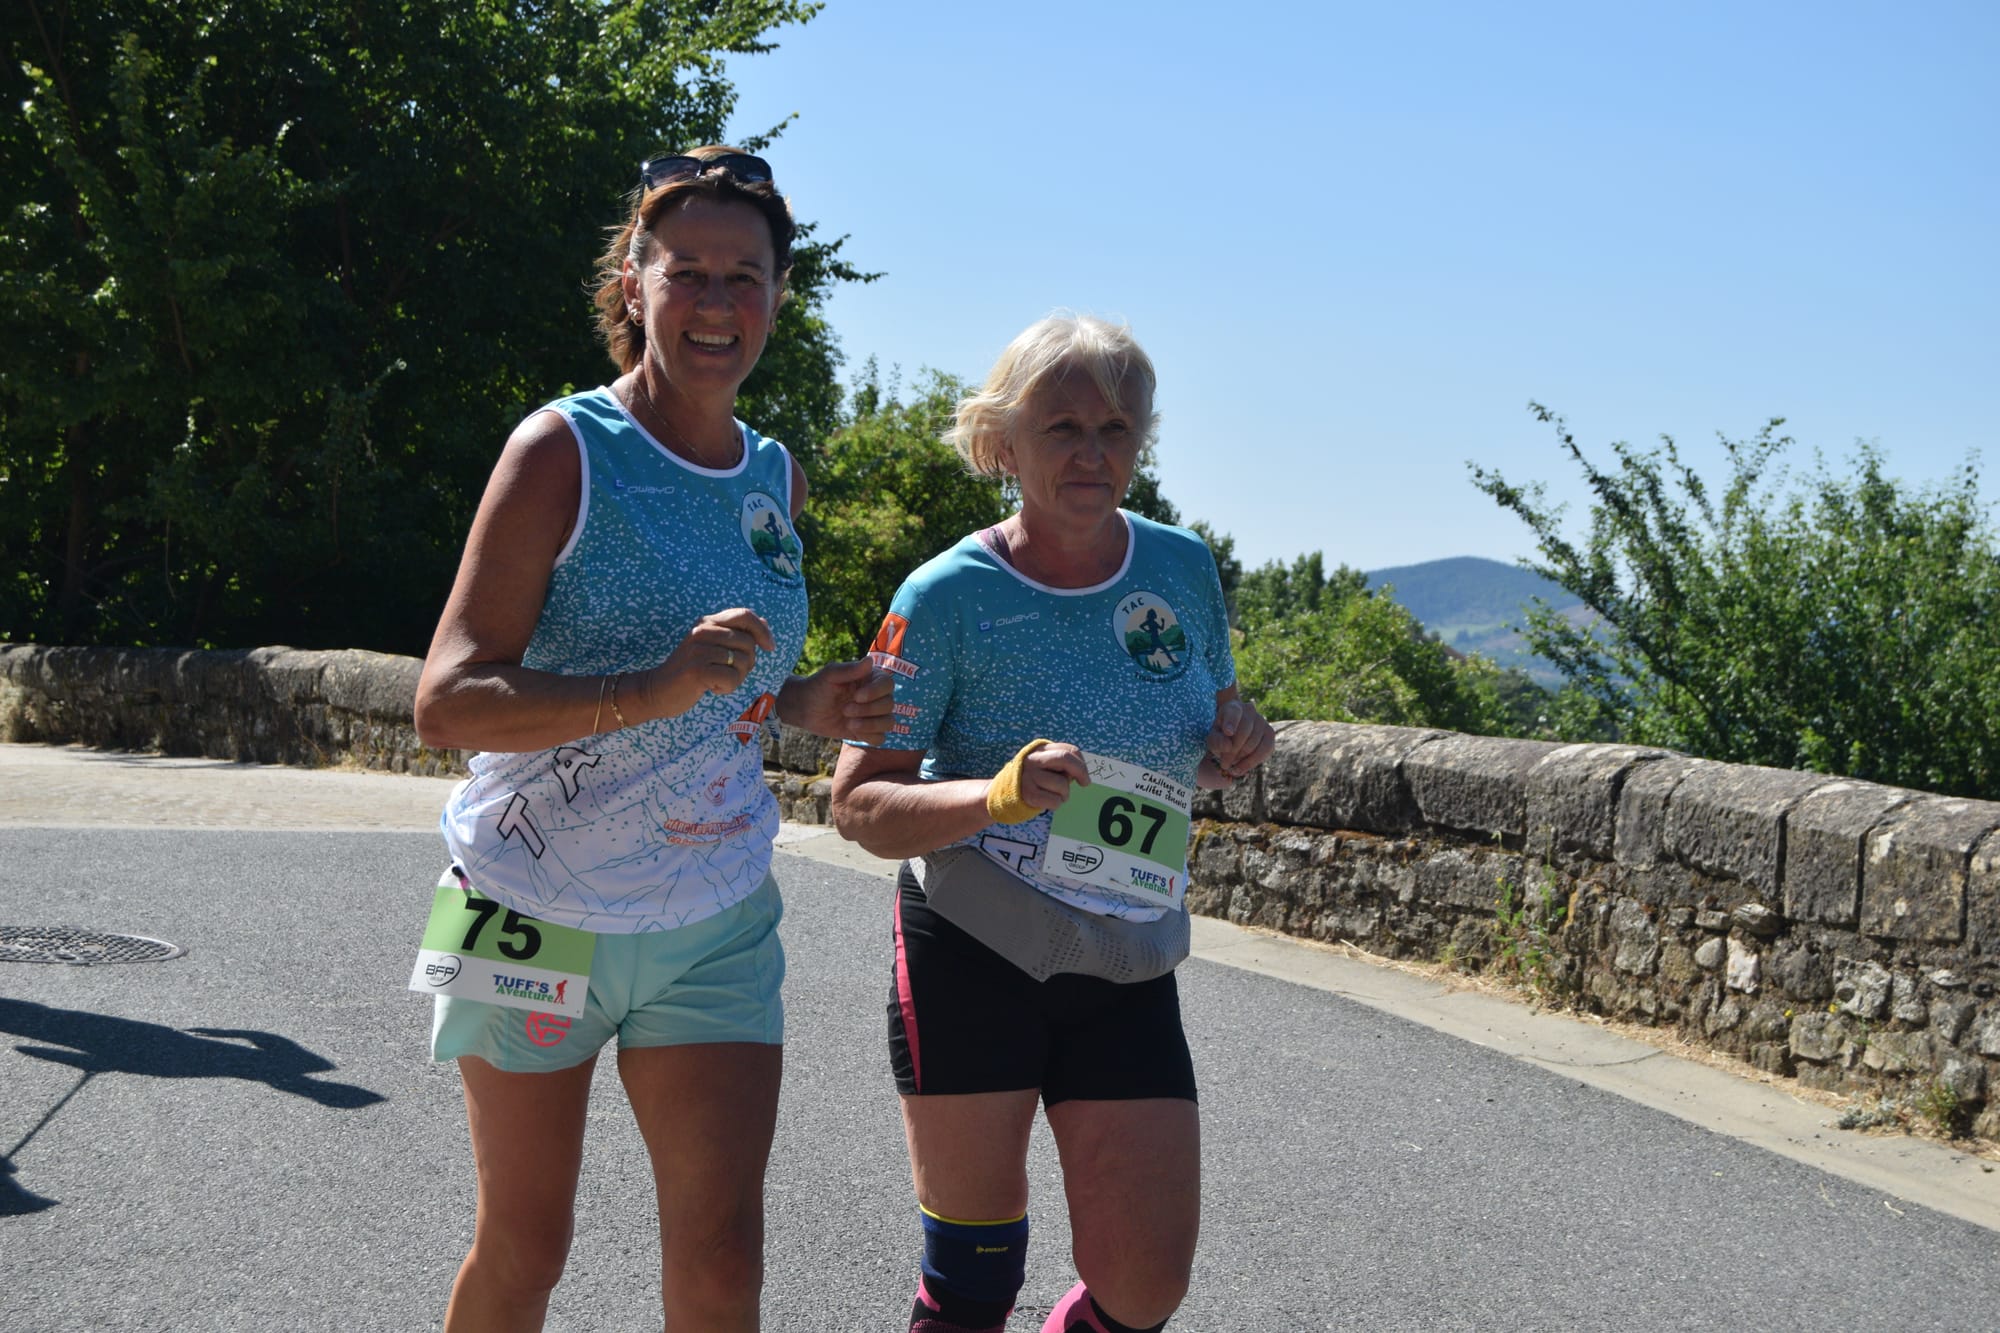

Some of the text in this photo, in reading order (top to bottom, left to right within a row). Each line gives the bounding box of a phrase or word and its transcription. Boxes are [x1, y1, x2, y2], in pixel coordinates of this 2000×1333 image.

[747, 499, 764, 512] TAC
[1122, 597, 1145, 615] TAC
[1098, 796, 1167, 855] 67
[1062, 850, 1097, 866] BFP
[1130, 867, 1167, 887] TUFF'S
[1132, 877, 1169, 895] Aventure
[461, 897, 542, 960] 75
[425, 964, 455, 977] BFP
[493, 974, 549, 993] TUFF'S
[496, 983, 554, 1001] Aventure
